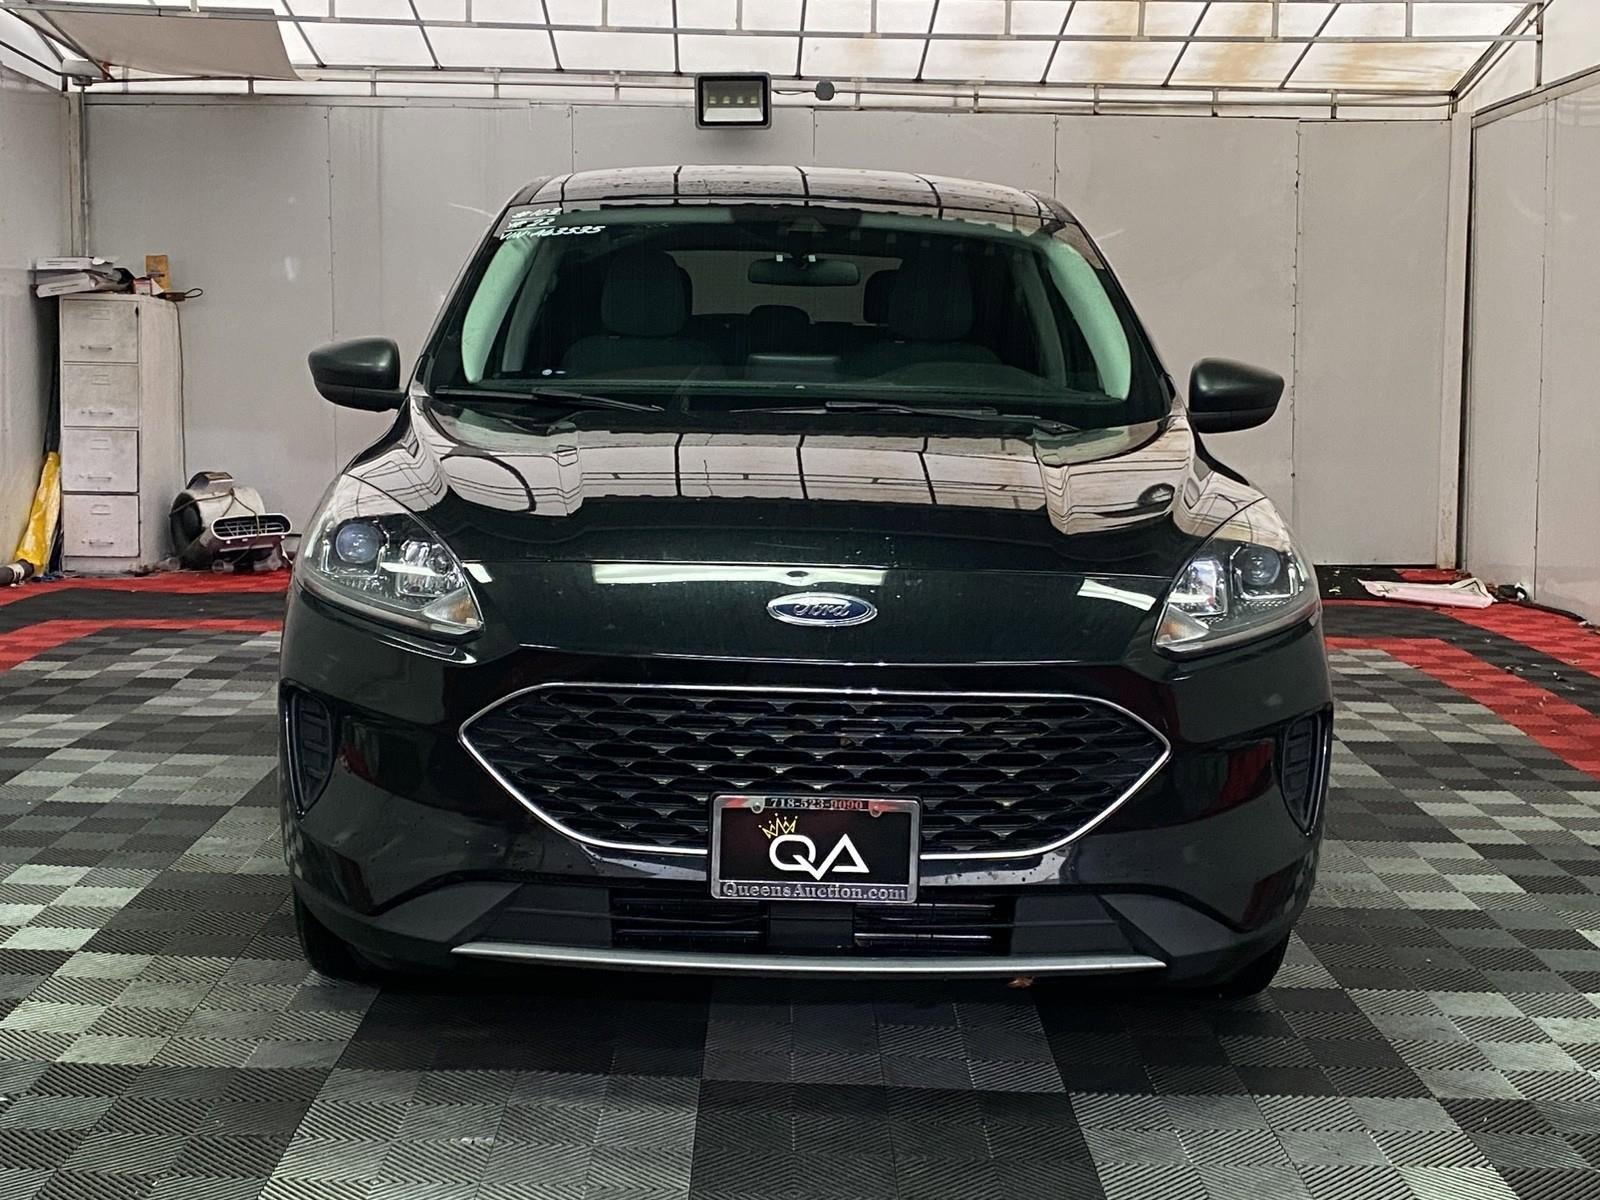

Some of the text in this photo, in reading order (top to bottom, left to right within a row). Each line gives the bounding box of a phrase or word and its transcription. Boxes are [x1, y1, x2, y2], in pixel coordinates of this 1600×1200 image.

[793, 602, 851, 616] Ford
[769, 833, 870, 881] QA
[723, 882, 906, 900] QueensAuction.com
